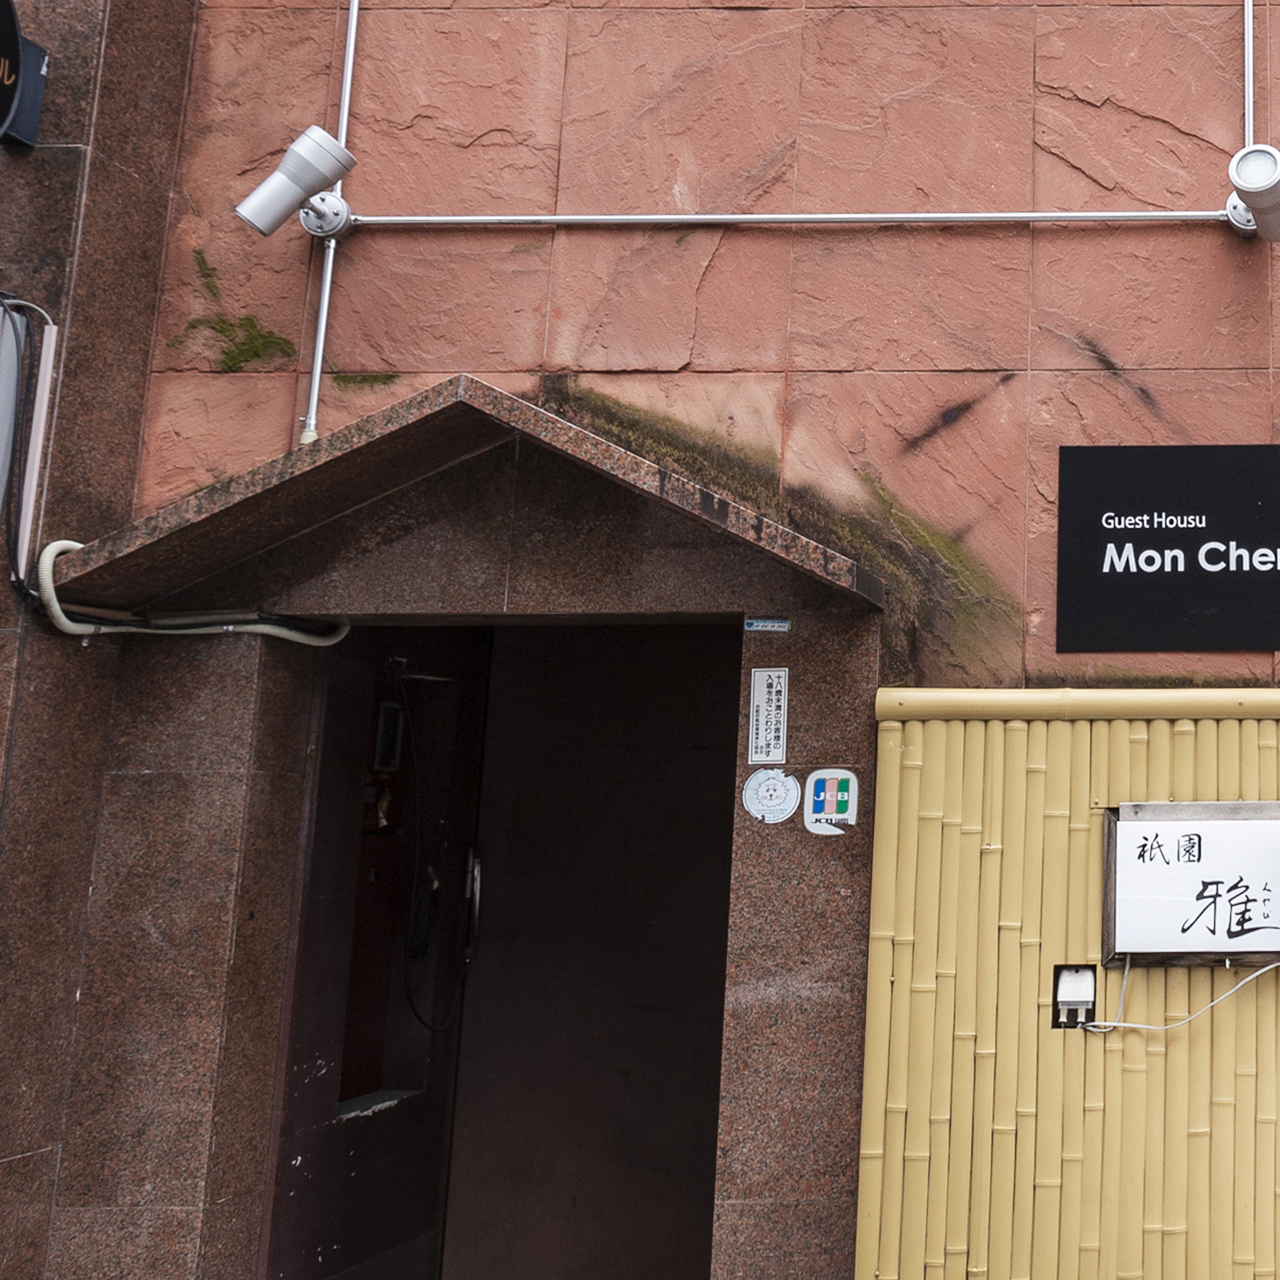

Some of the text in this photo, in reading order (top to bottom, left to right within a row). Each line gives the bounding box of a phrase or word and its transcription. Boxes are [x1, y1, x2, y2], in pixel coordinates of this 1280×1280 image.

[1101, 511, 1207, 529] Guest Housu
[1102, 542, 1185, 573] Mon
[813, 791, 849, 801] JCB
[1137, 833, 1202, 866] 祇園
[1180, 875, 1280, 940] 雅
